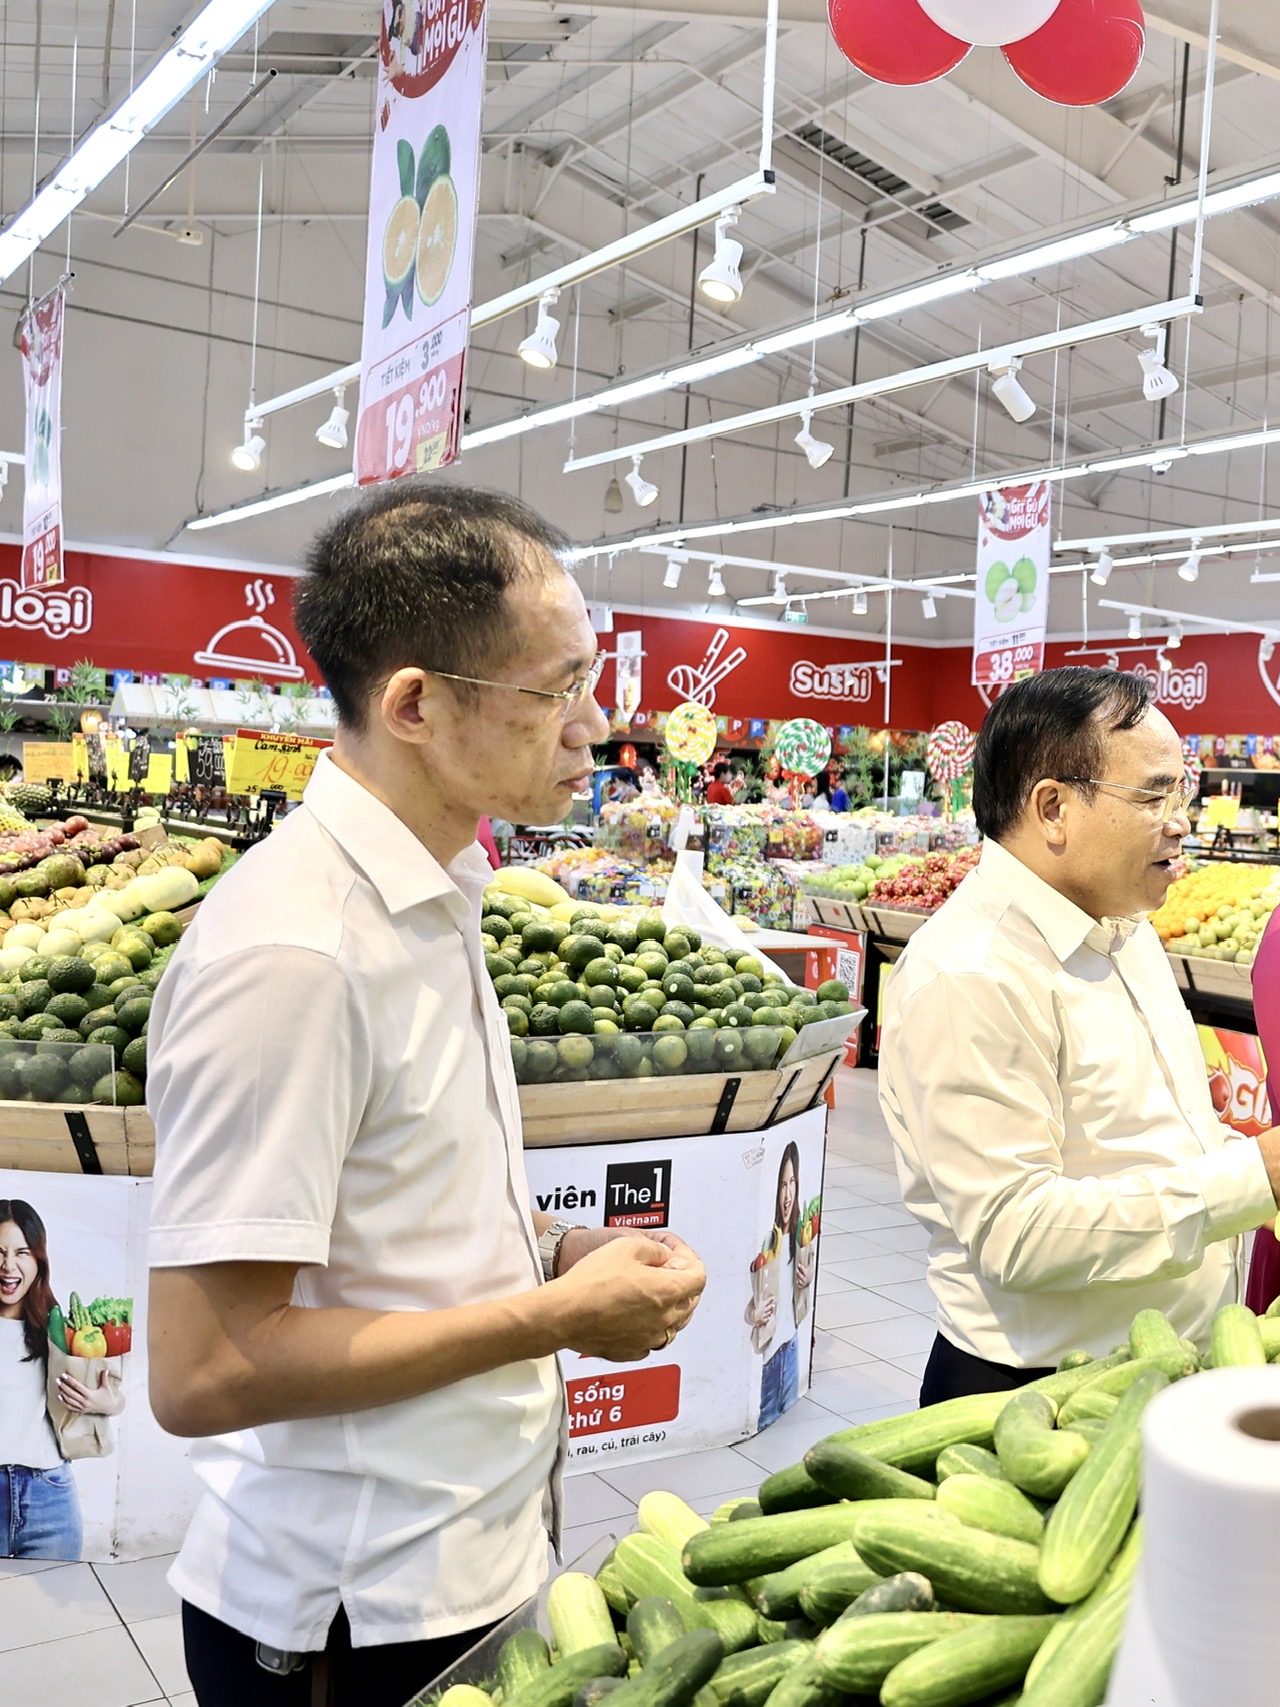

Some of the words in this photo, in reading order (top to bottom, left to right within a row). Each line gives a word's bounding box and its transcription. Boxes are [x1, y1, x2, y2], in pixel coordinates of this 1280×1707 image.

[2, 585, 84, 633] loại
[796, 666, 867, 697] Sushi
[1162, 669, 1204, 704] loại
[536, 1185, 597, 1211] viên
[615, 1215, 660, 1227] Vietnam
[573, 1381, 625, 1404] sống
[568, 1408, 603, 1430] thứ
[609, 1406, 622, 1422] 6
[577, 1445, 598, 1456] rau,
[601, 1438, 618, 1450] củ,
[621, 1434, 640, 1448] trái
[642, 1431, 667, 1443] cây)
